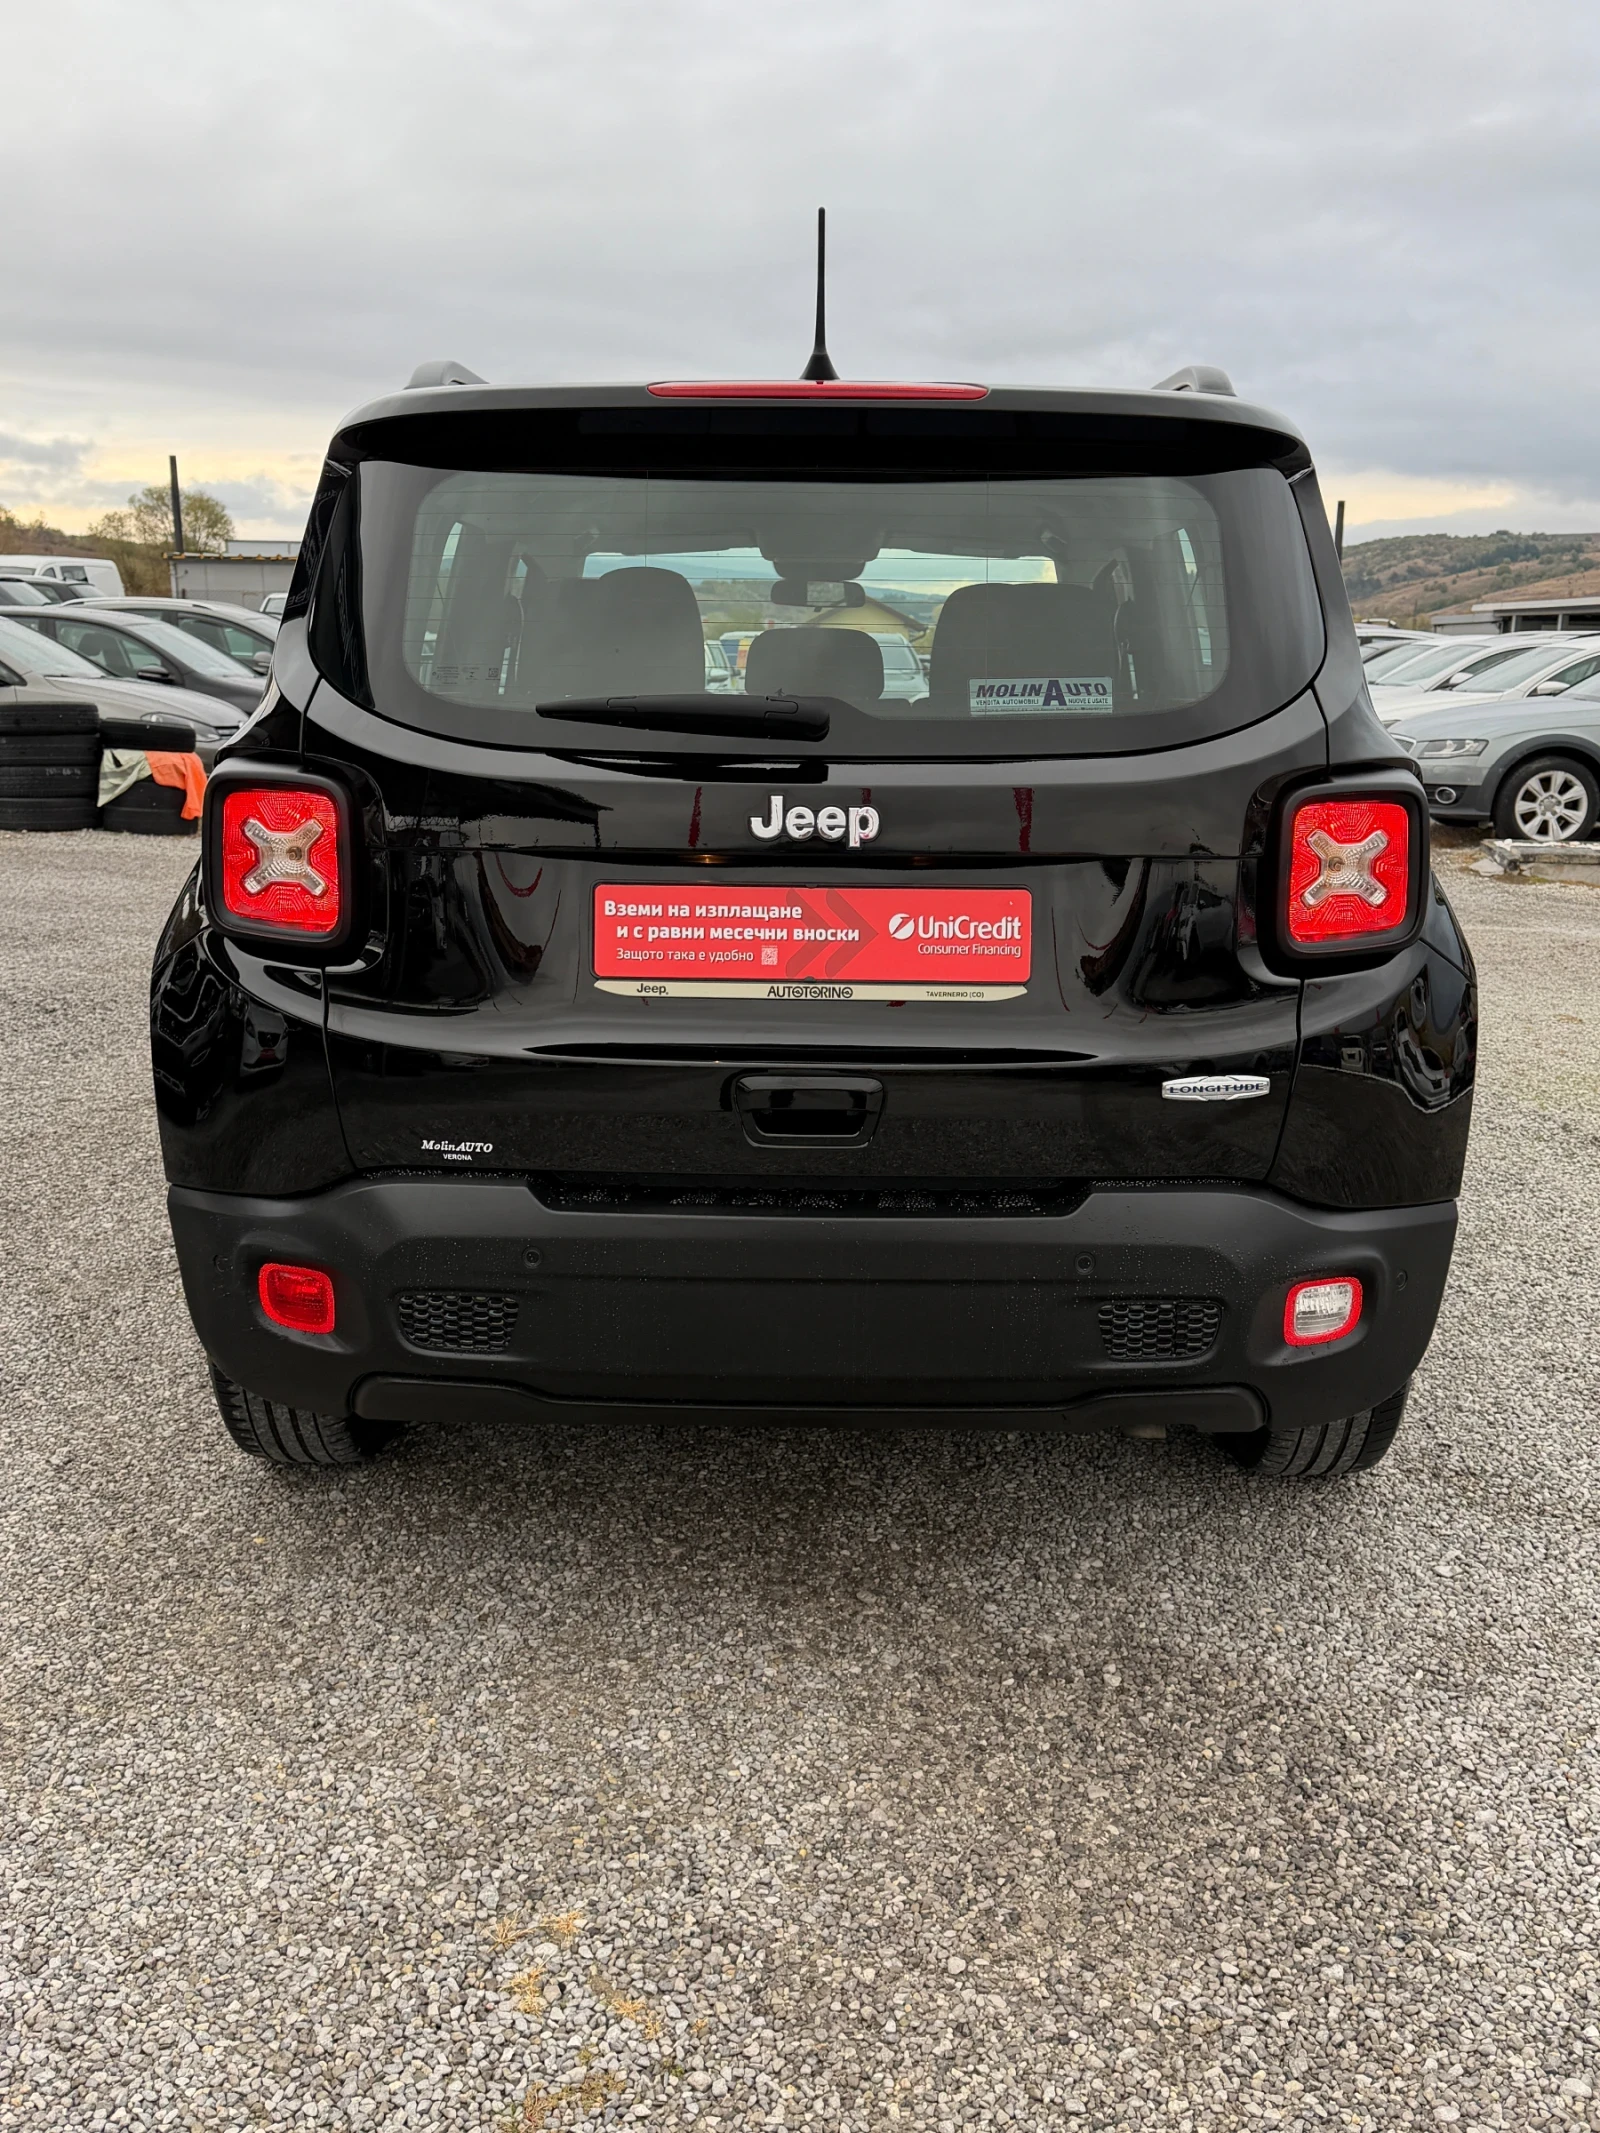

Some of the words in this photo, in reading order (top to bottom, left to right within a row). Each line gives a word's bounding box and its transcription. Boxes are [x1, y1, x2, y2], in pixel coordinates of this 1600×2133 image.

[750, 795, 880, 848] Jeep
[604, 900, 663, 917] Вземи
[668, 904, 690, 917] на
[695, 905, 803, 922] изплащане
[616, 925, 628, 938] и
[633, 926, 643, 939] с
[648, 926, 705, 942] равни
[710, 927, 788, 941] месечни
[793, 928, 860, 942] вноски
[918, 915, 1022, 940] UniCredit
[616, 948, 664, 962] Защото
[667, 950, 695, 961] така
[699, 950, 706, 961] е
[709, 949, 754, 964] удобно
[918, 943, 970, 955] Consumer
[972, 943, 1022, 958] Financing
[767, 985, 853, 999] AUTOTORINO
[969, 991, 985, 999] (CO)
[1169, 1083, 1264, 1094] LONGITUDE
[421, 1139, 494, 1153] MolinAUTO
[442, 1153, 472, 1161] VERONA
